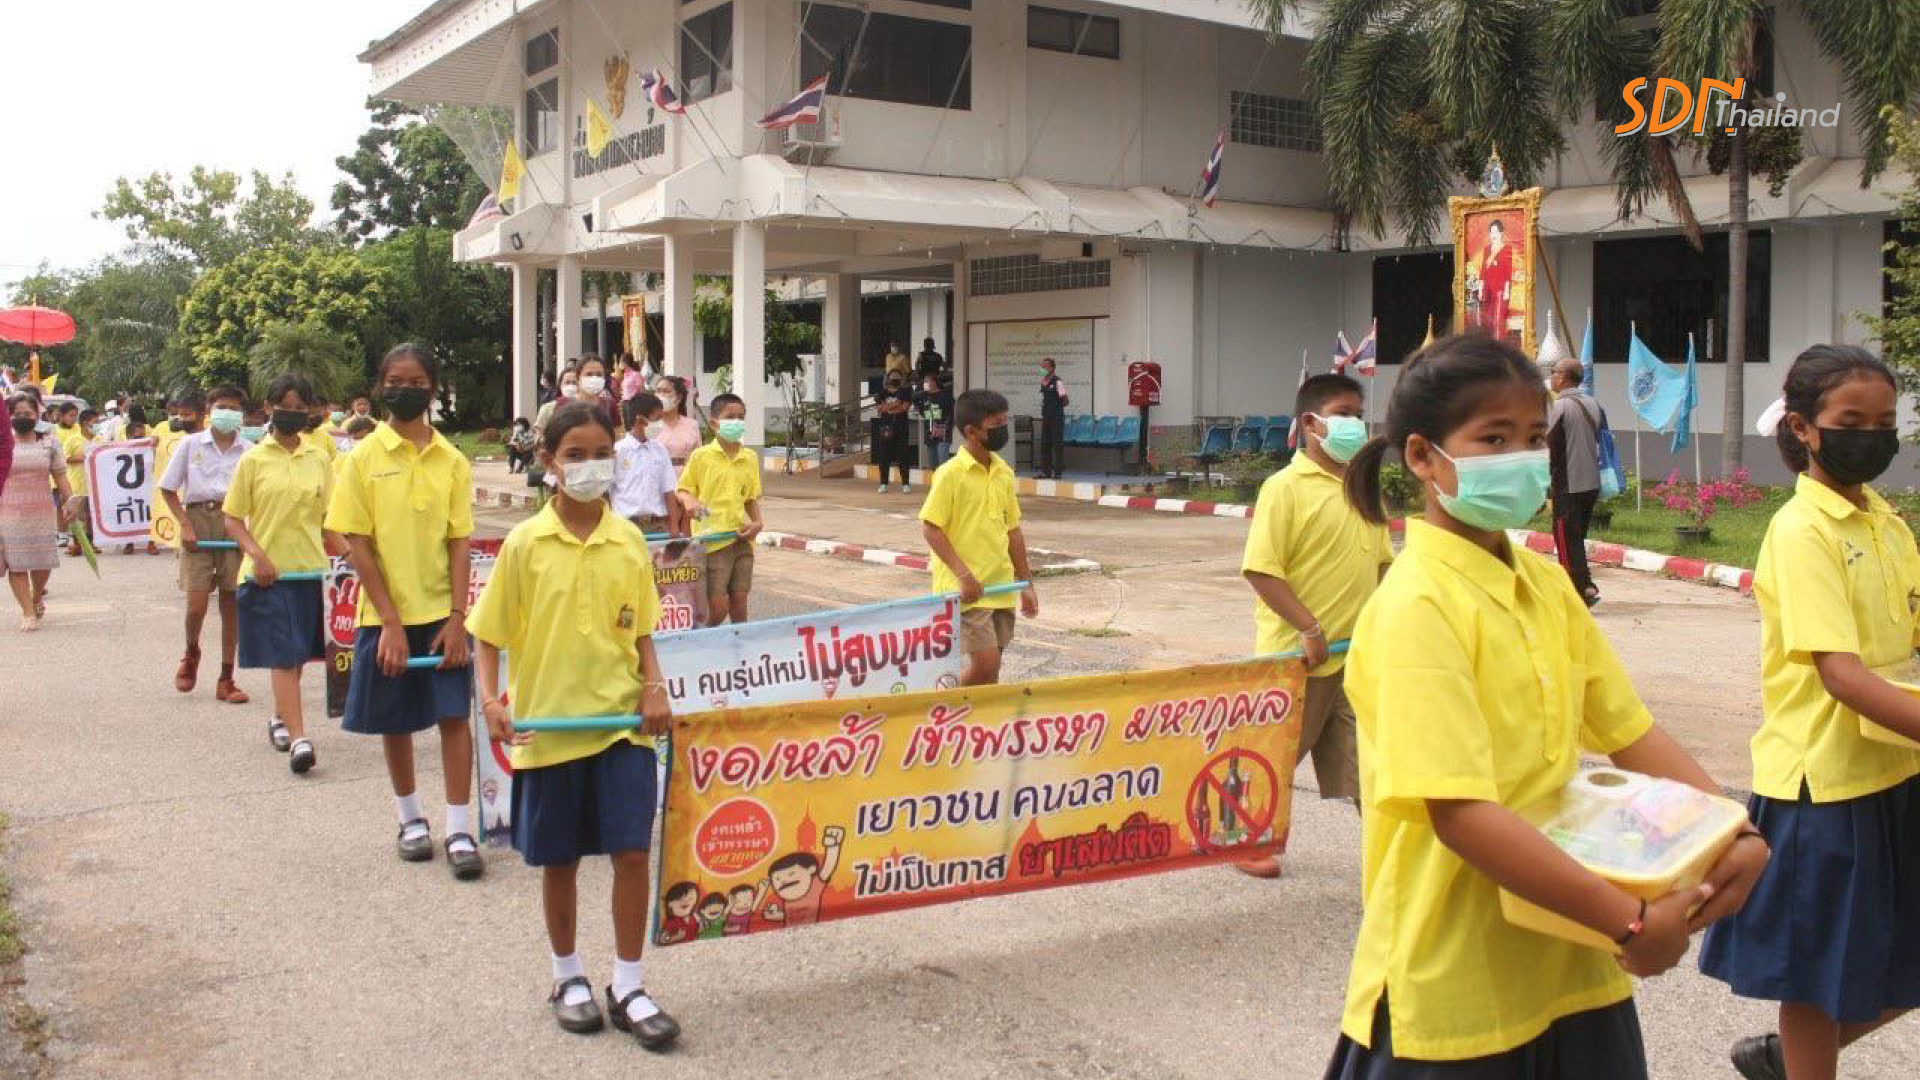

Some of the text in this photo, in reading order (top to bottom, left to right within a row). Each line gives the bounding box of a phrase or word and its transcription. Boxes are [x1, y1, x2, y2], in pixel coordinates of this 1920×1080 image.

[689, 713, 884, 790] งดเหล้า
[903, 704, 1105, 768] เข้าพรรษา
[856, 765, 1161, 835] เยาวชน คนฉลาด
[854, 810, 1171, 896] ไม่เป็นทาส ยาเสพติด
